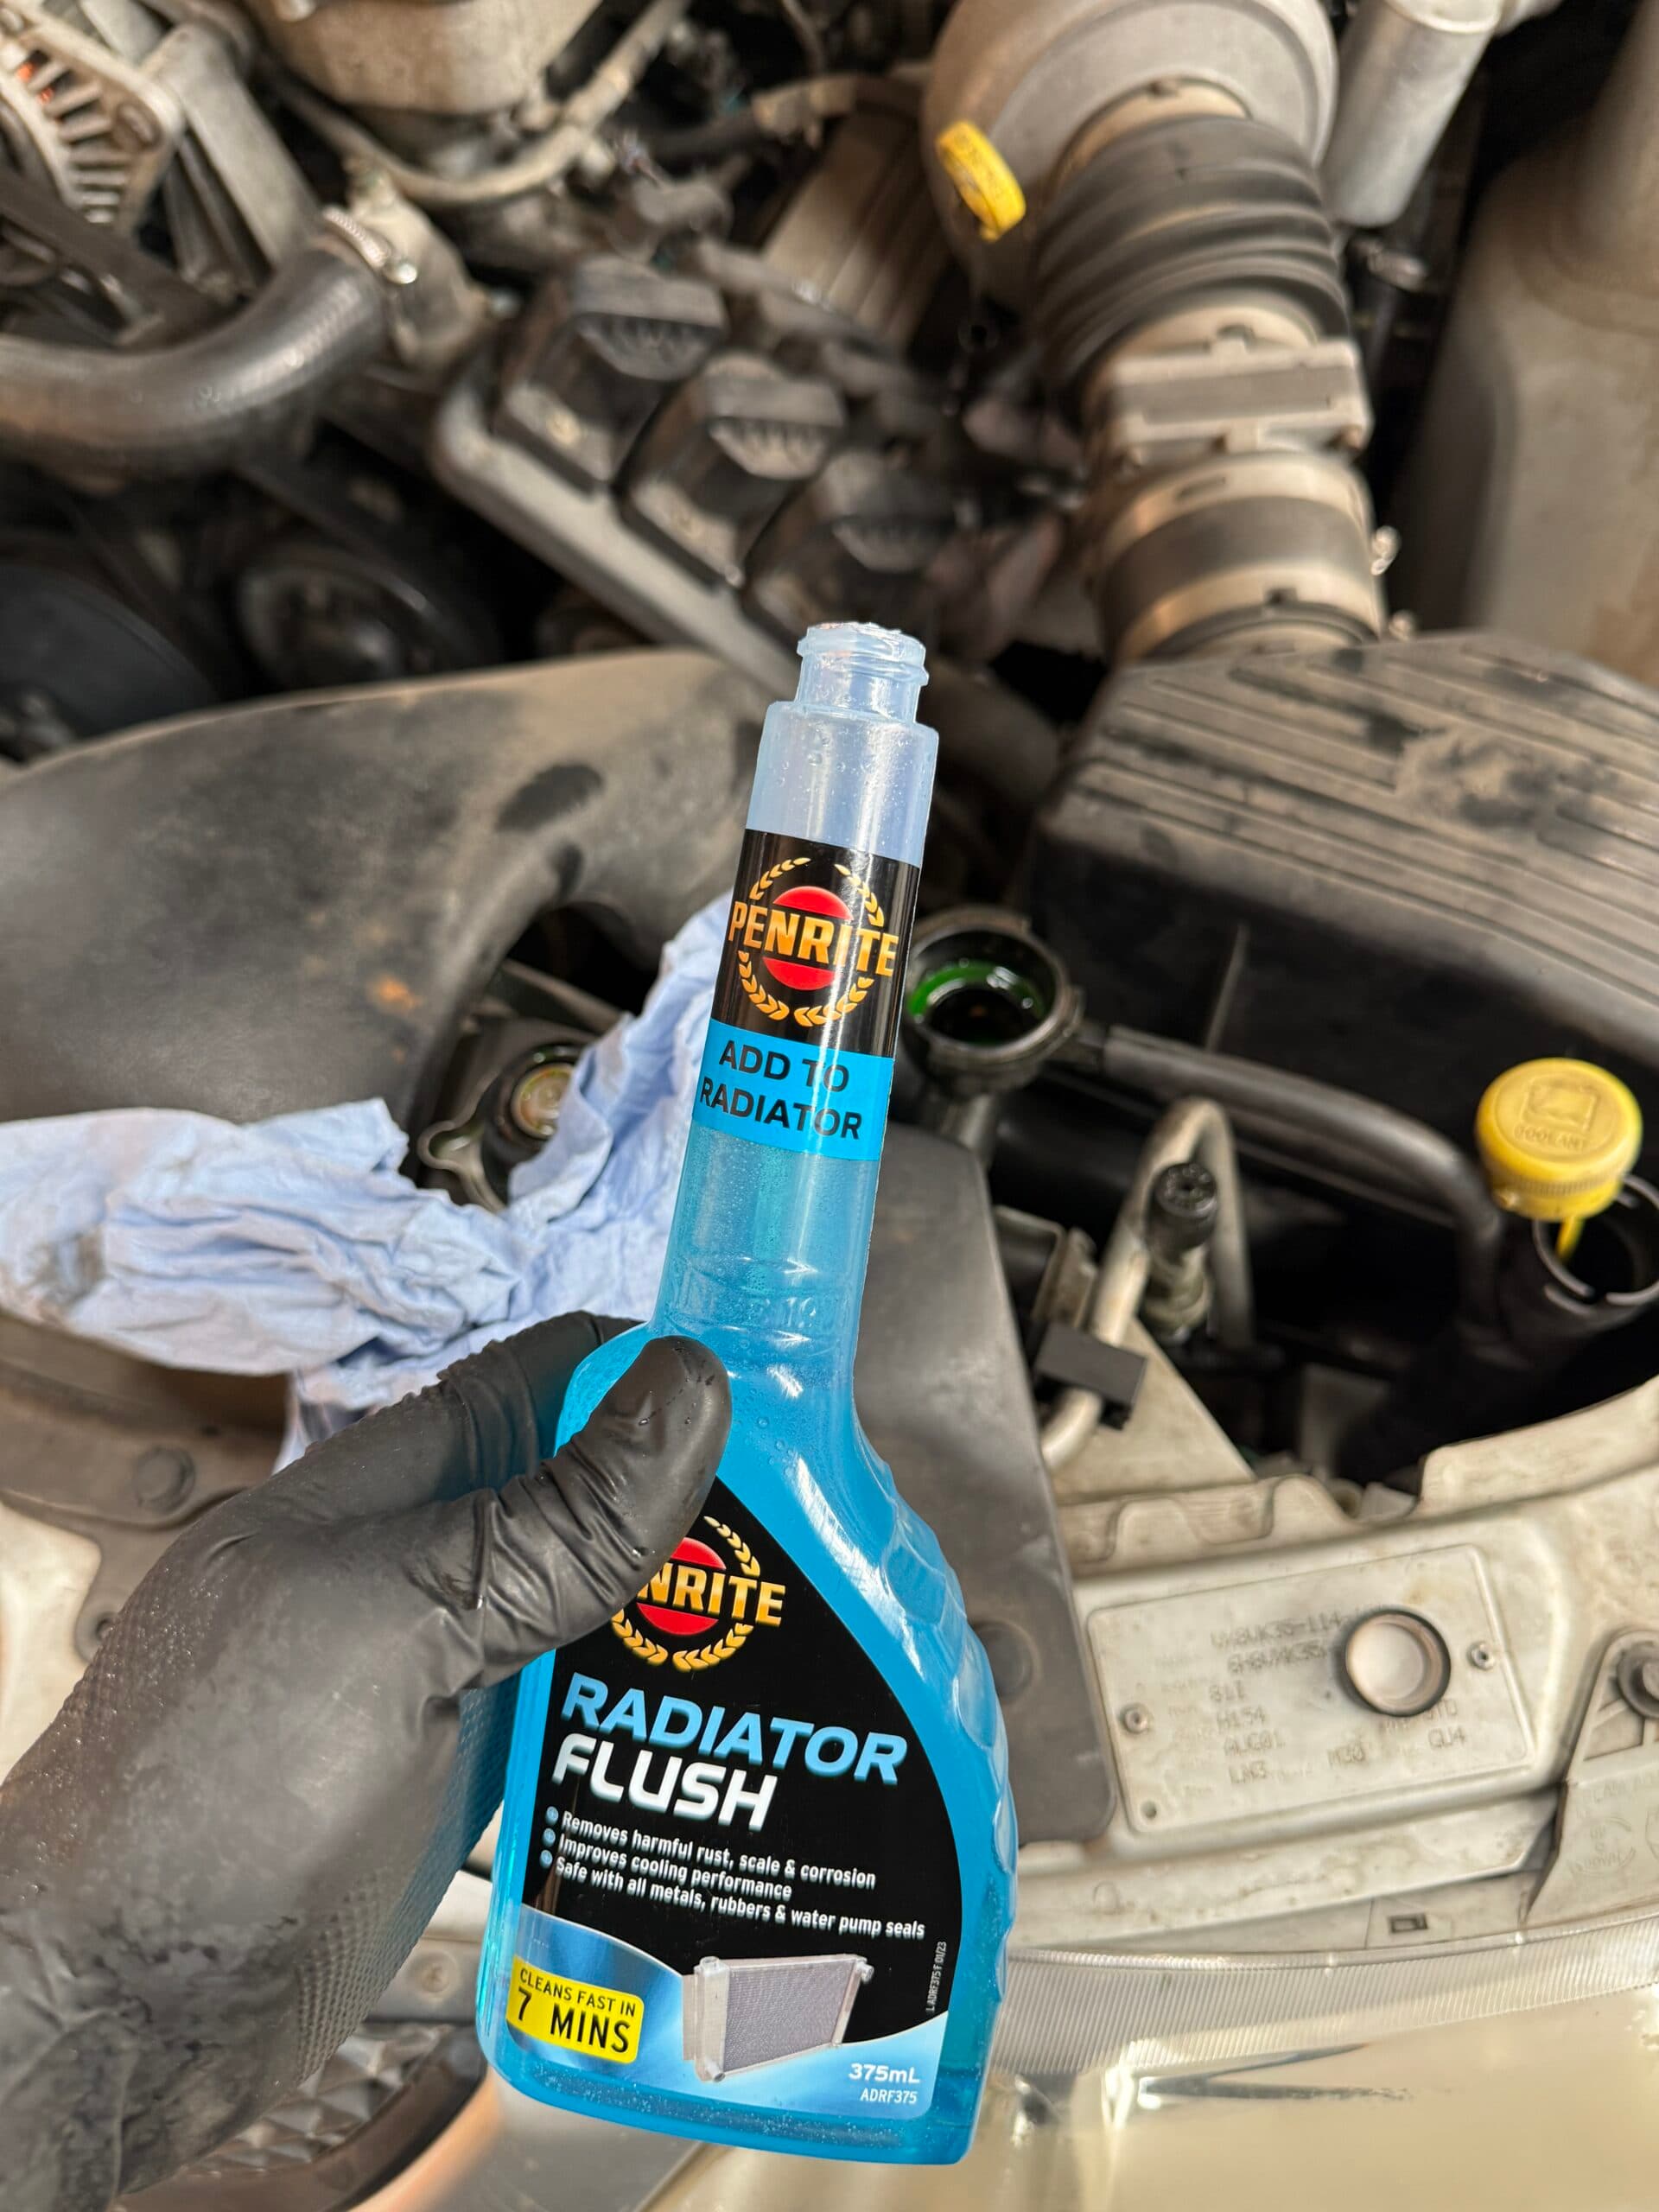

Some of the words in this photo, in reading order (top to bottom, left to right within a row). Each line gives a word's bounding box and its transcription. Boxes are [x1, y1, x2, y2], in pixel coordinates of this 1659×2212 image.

[728, 900, 899, 978] PENRITE
[719, 1040, 791, 1081] ADD
[801, 1059, 850, 1092] TO
[699, 1077, 863, 1140] RADIATOR
[1513, 1123, 1589, 1151] COOLANT
[637, 1562, 786, 1627] NRITE
[561, 1672, 908, 1785] RADIATOR
[551, 1732, 779, 1833] FLUSH
[558, 1833, 627, 1870] Improves
[631, 1856, 688, 1885] cooling
[691, 1868, 792, 1902] performance
[562, 1810, 628, 1847] Removes
[632, 1828, 693, 1860] harmful
[696, 1845, 734, 1871] rust,
[739, 1853, 780, 1877] scale
[784, 1859, 796, 1879] &
[800, 1864, 876, 1890] corrosion
[556, 1855, 588, 1884] Safe
[591, 1868, 624, 1892] with
[626, 1878, 646, 1898] all
[650, 1883, 707, 1913] metals,
[710, 1895, 772, 1923] rubbers
[774, 1904, 786, 1924] &
[791, 1908, 836, 1930] water
[838, 1915, 882, 1939] pump
[885, 1920, 926, 1941] seals
[518, 1986, 532, 2022] 7
[550, 2003, 631, 2054] MINS
[519, 1967, 573, 2001] CLEANS
[576, 1990, 616, 2012] FAST
[620, 1999, 636, 2018] IN
[848, 2063, 920, 2084] 375mL
[860, 2088, 918, 2105] ADRF375
